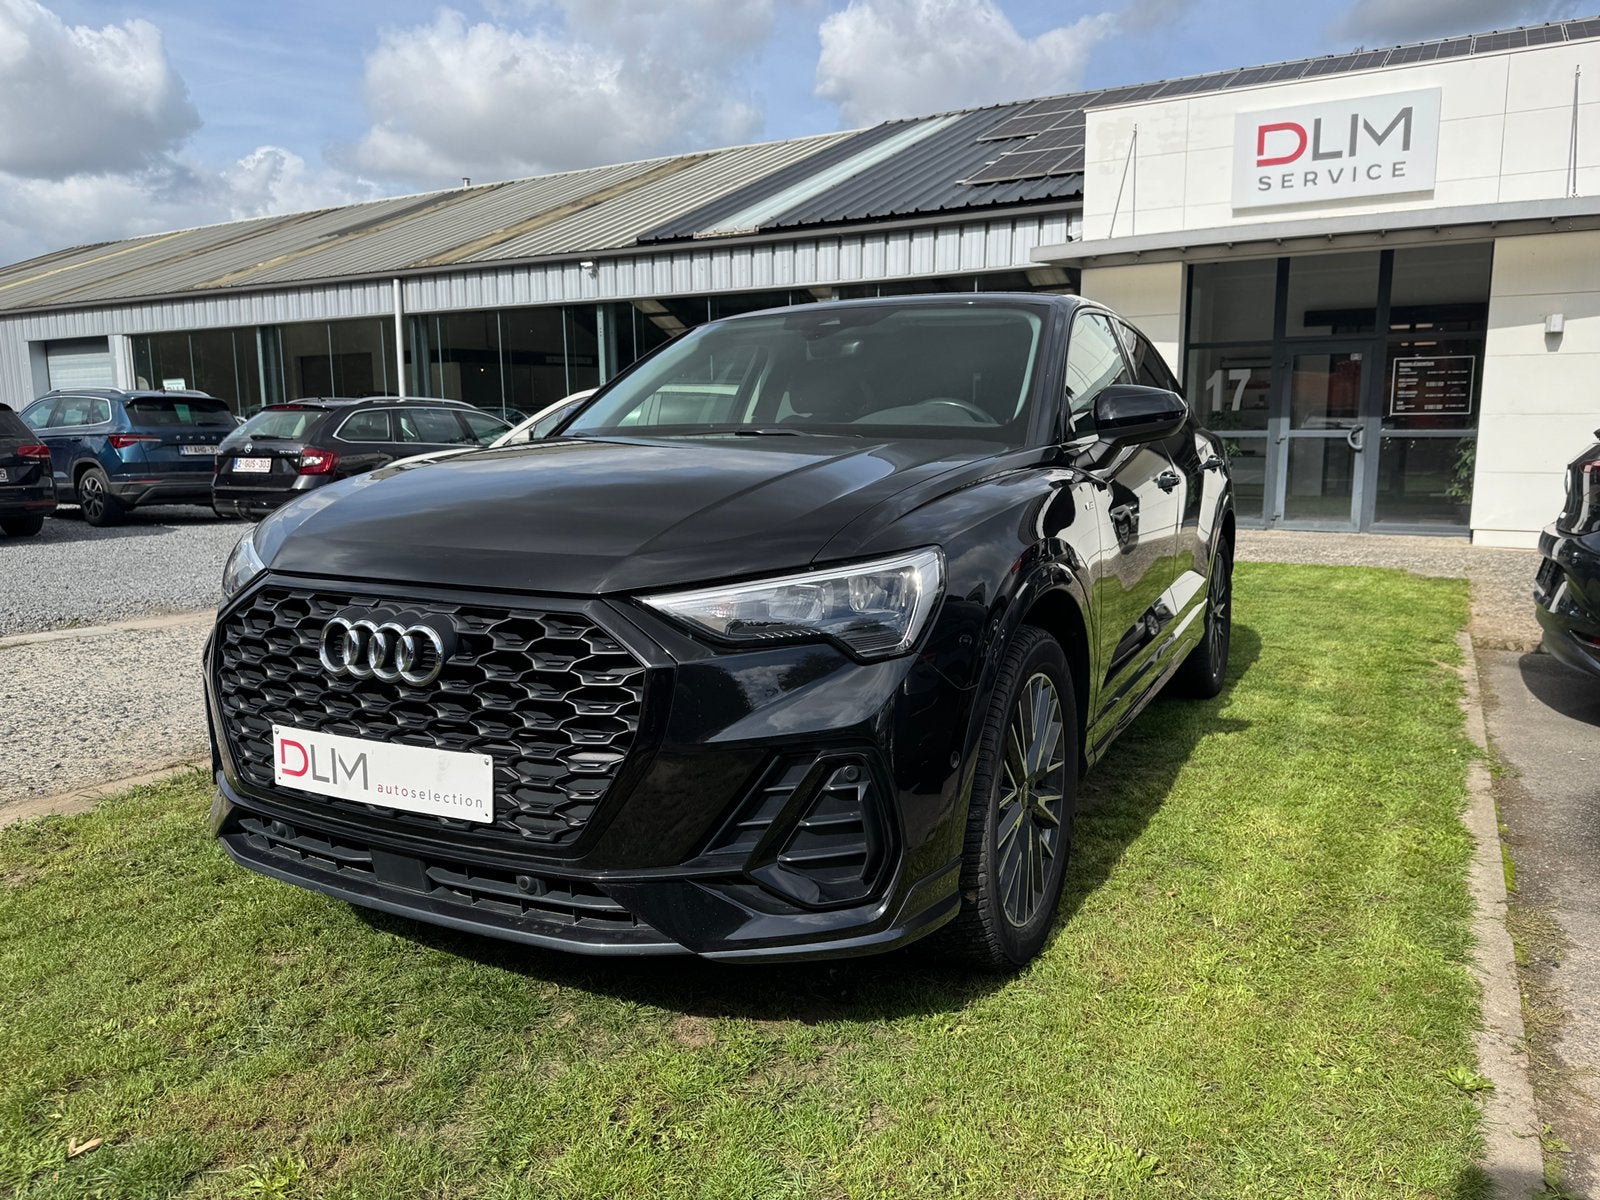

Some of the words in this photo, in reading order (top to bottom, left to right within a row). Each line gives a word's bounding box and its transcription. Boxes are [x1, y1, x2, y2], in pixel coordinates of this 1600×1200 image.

[1256, 106, 1413, 167] DLM
[1257, 161, 1407, 191] SERVICE
[1205, 368, 1252, 412] 17
[280, 738, 369, 791] DLM
[377, 783, 483, 809] autoselection
